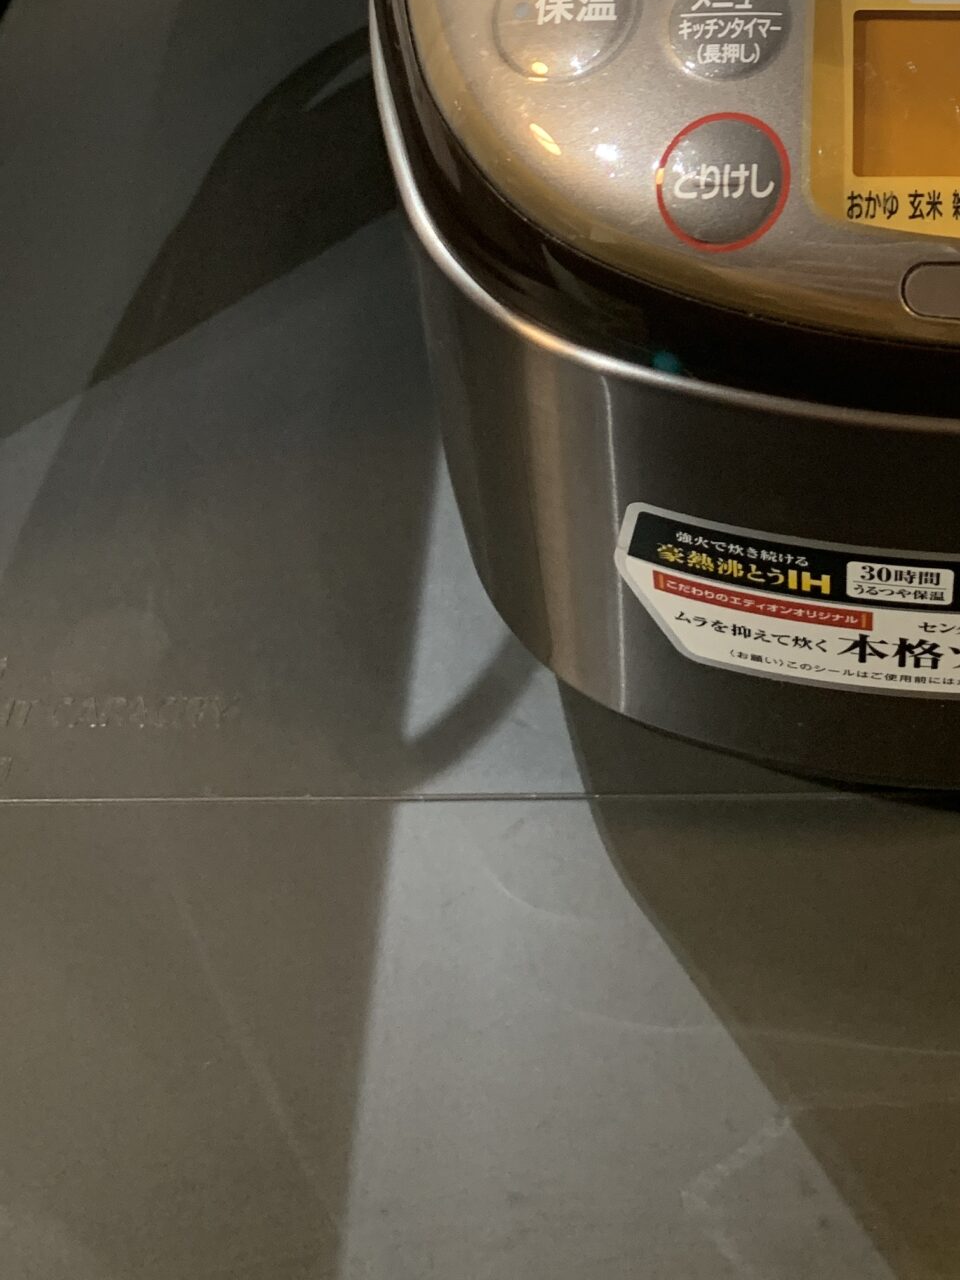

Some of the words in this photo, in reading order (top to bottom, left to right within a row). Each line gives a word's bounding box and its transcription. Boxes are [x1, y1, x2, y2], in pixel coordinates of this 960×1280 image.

[678, 17, 782, 40] キッチンタイマー
[697, 43, 760, 65] (長押し)
[674, 163, 775, 201] とりけし
[847, 191, 899, 220] おかゆ
[908, 190, 944, 220] 玄米
[676, 531, 808, 567] 強火で炊き続ける
[861, 566, 941, 586] 30時間
[665, 579, 859, 625] こだわりのエディオンオリジナル
[852, 584, 946, 602] うるつや保温
[675, 611, 828, 653] ムラを抑えて炊く
